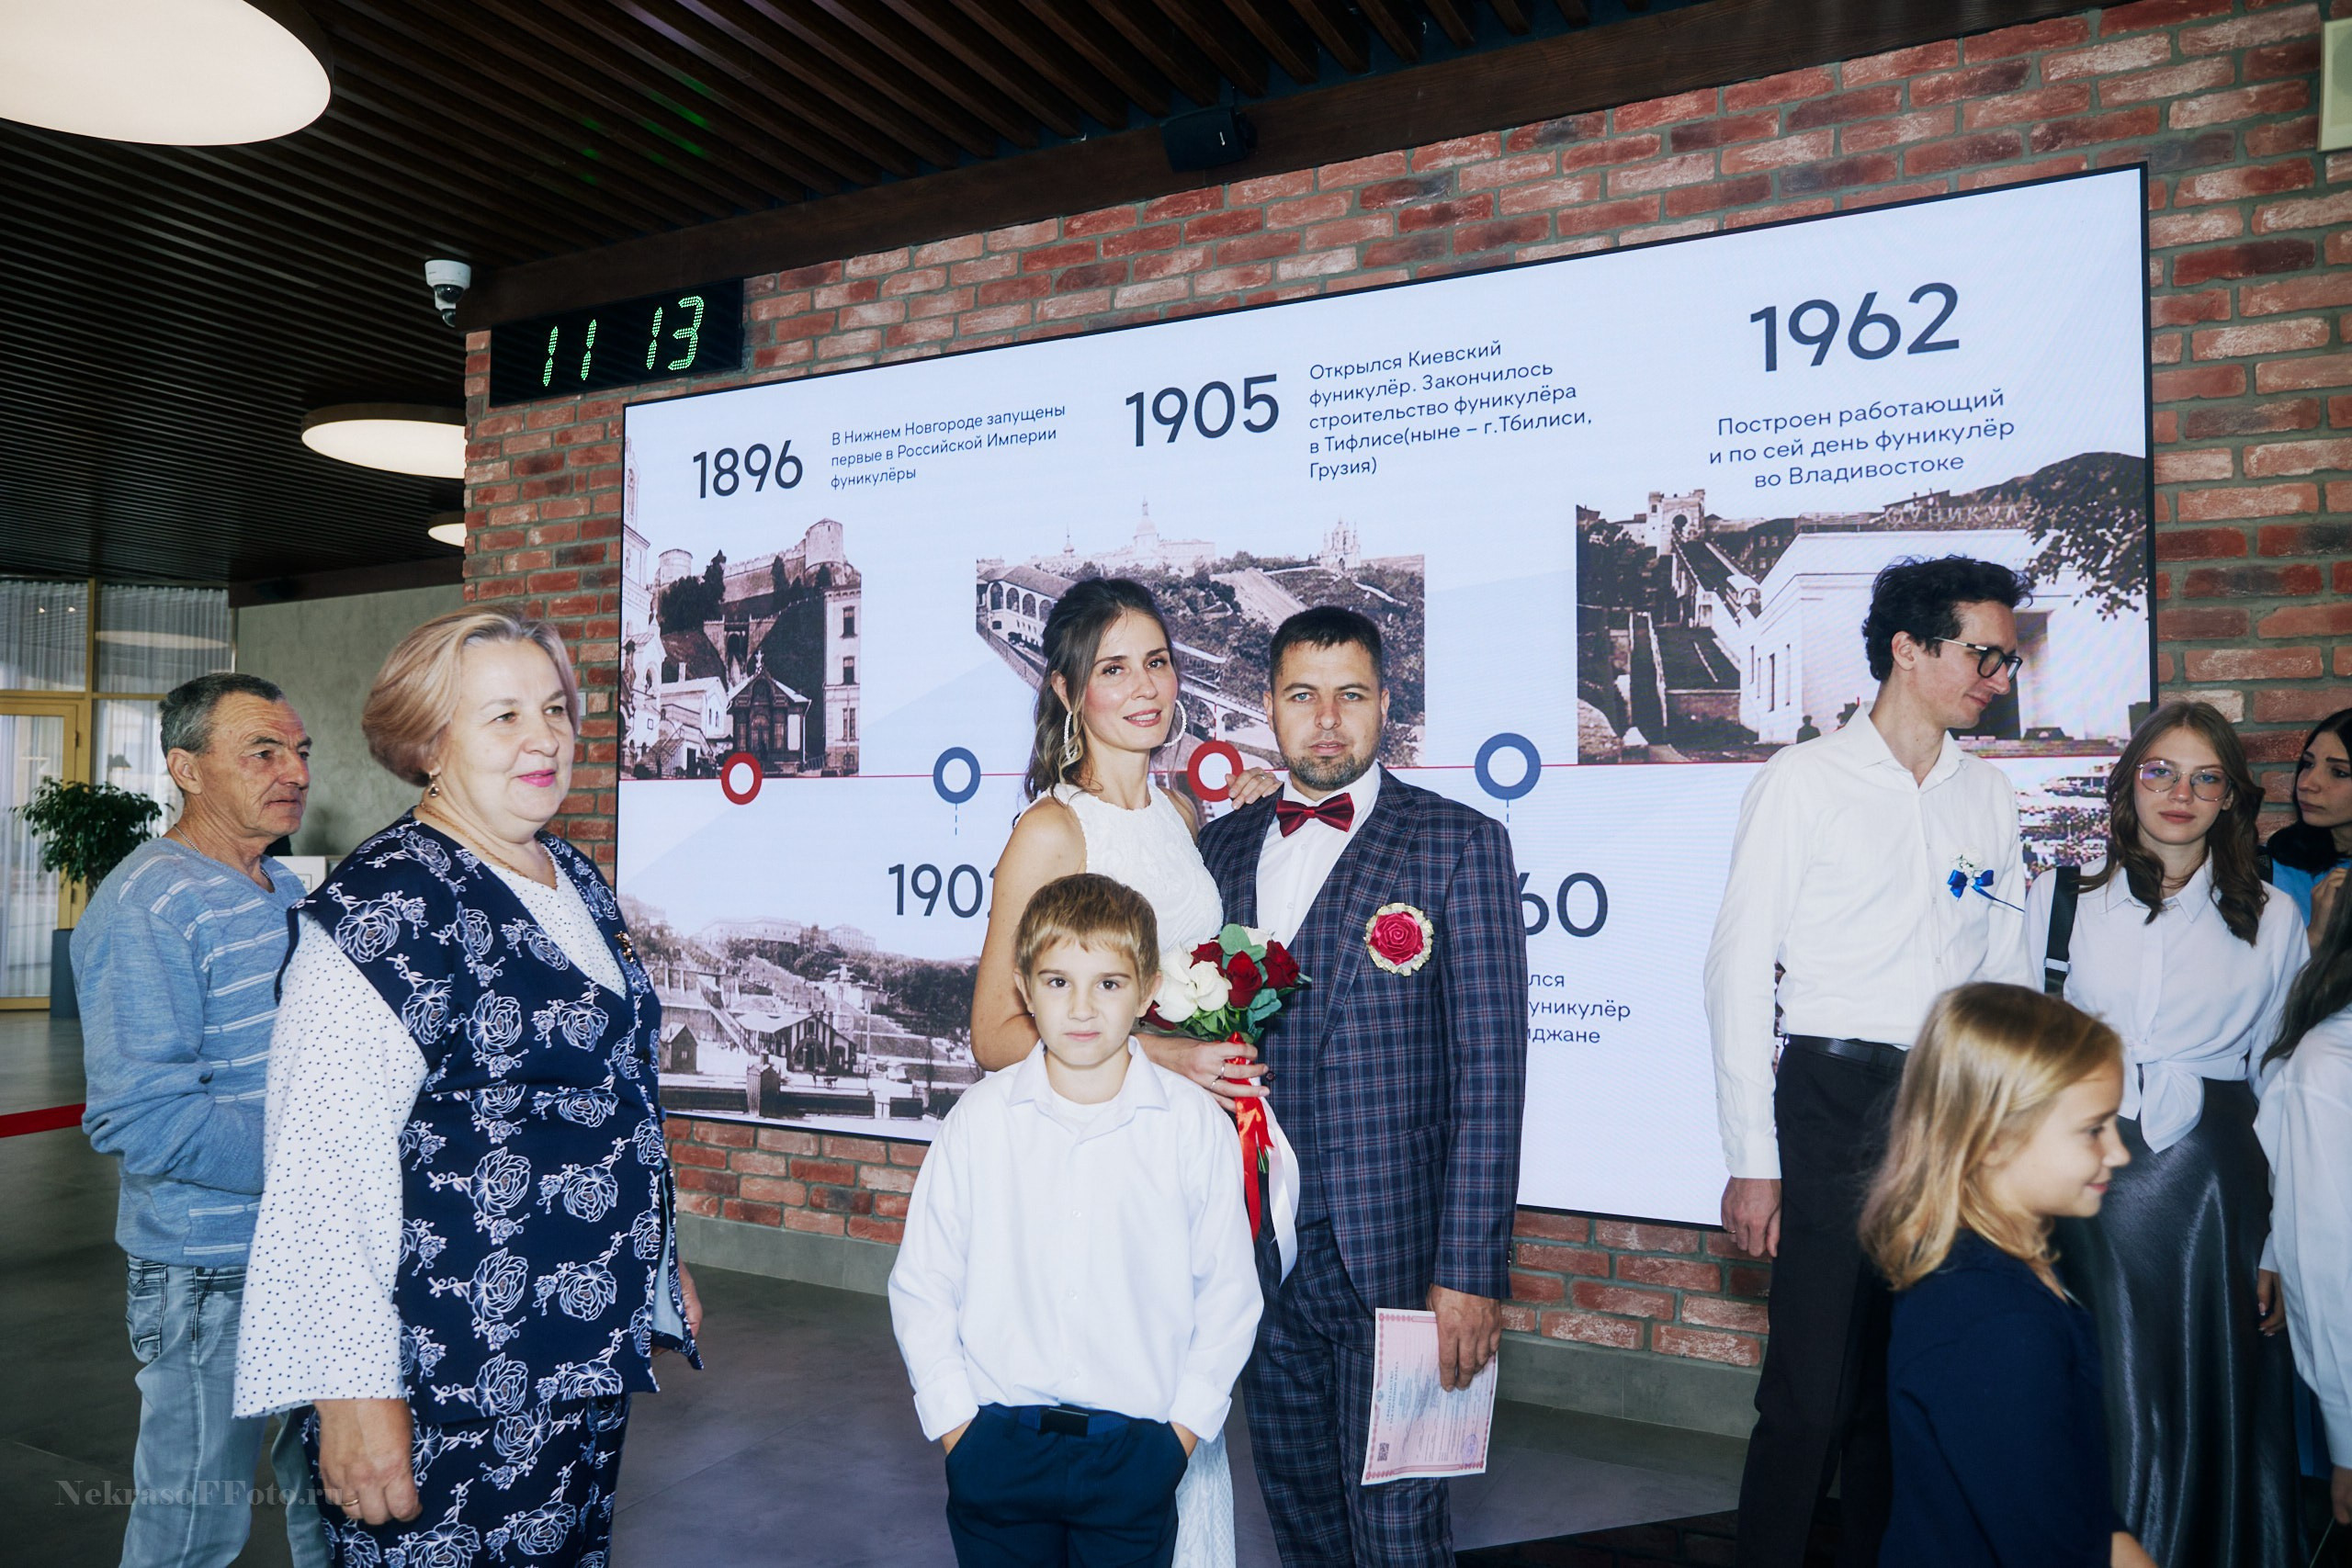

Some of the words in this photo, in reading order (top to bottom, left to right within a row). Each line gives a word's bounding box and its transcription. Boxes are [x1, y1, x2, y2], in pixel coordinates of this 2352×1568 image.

[543, 319, 597, 387] 11
[646, 296, 705, 370] 13
[1750, 283, 1959, 372] 1962
[1310, 358, 1401, 381] Открылся
[1409, 340, 1500, 367] Киевский
[1310, 379, 1416, 407] фуникулёр.
[1423, 365, 1553, 389] Закончилось
[832, 433, 840, 446] В
[845, 428, 900, 444] Нижнем
[906, 417, 982, 438] Новгороде
[988, 406, 1065, 425] запущены
[1126, 374, 1279, 446] 1905
[1310, 403, 1448, 430] строительство
[1454, 384, 1577, 417] фуникулёра
[1719, 412, 1830, 435] Построен
[1838, 389, 2005, 425] работающий
[832, 452, 882, 468] первые
[887, 450, 893, 459] в
[899, 435, 981, 457] Российской
[988, 430, 1056, 446] Империи
[1310, 443, 1318, 453] в
[1324, 423, 1461, 453] Тифлисе(ныне
[1485, 412, 1591, 434] г.Тбилиси,
[1711, 452, 1721, 464] и
[1730, 449, 1756, 462] по
[1764, 439, 1803, 458] сей
[1811, 438, 1868, 457] день
[1876, 419, 2014, 451] фуникулёр
[694, 440, 802, 499] 1896
[831, 469, 915, 490] фуникулёры
[1311, 457, 1376, 480] Грузия)
[1756, 475, 1781, 488] во
[1790, 457, 1963, 484] Владивостоке
[888, 863, 996, 919] 190
[1529, 1000, 1630, 1021] уникулёр
[1527, 1026, 1600, 1043] джане
